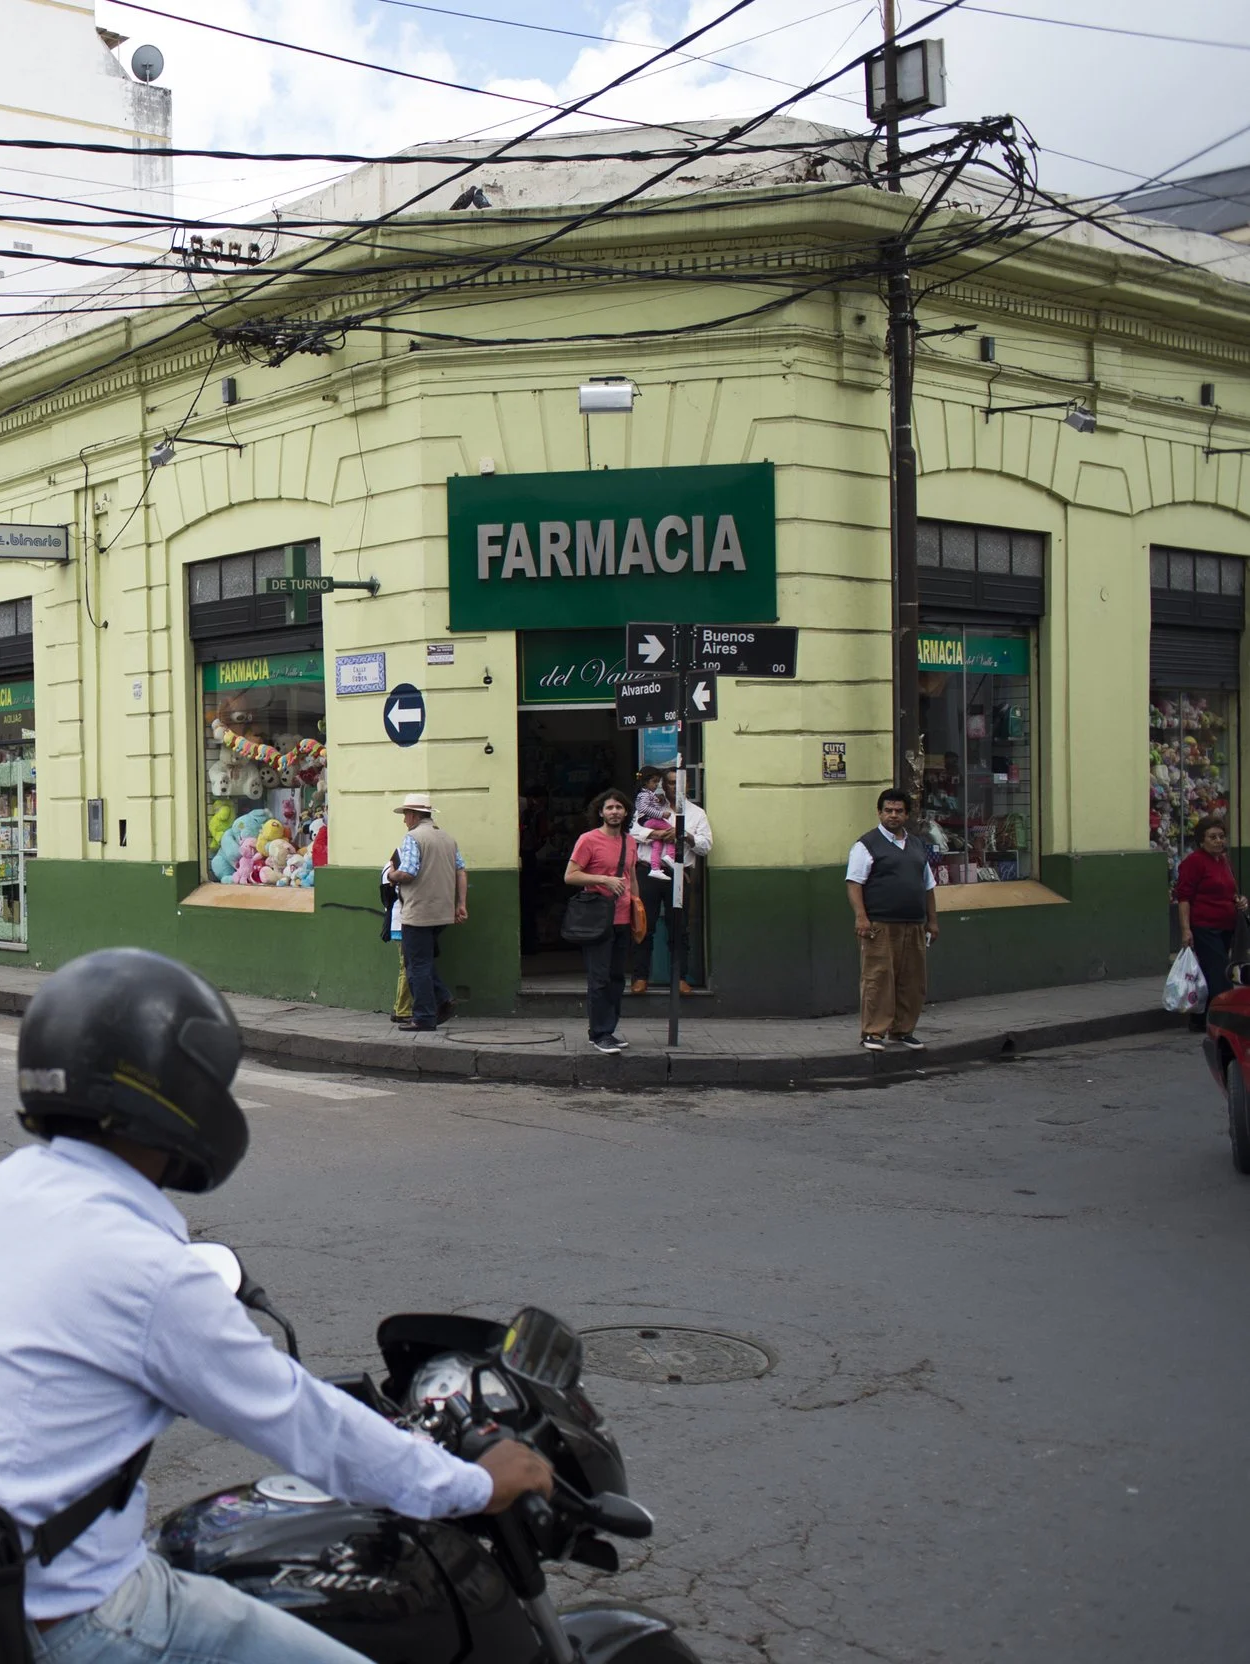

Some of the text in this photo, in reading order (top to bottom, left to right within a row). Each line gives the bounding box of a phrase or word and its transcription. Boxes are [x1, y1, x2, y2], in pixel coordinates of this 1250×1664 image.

[477, 514, 746, 579] FARMACIA
[272, 579, 329, 590] DE TURNO
[703, 629, 755, 643] Buenos
[702, 642, 738, 654] Aires
[918, 639, 963, 665] ARMACIA
[219, 658, 270, 684] FARMACIA
[539, 665, 575, 687] del
[621, 682, 661, 697] Alvarado
[624, 715, 636, 725] 700
